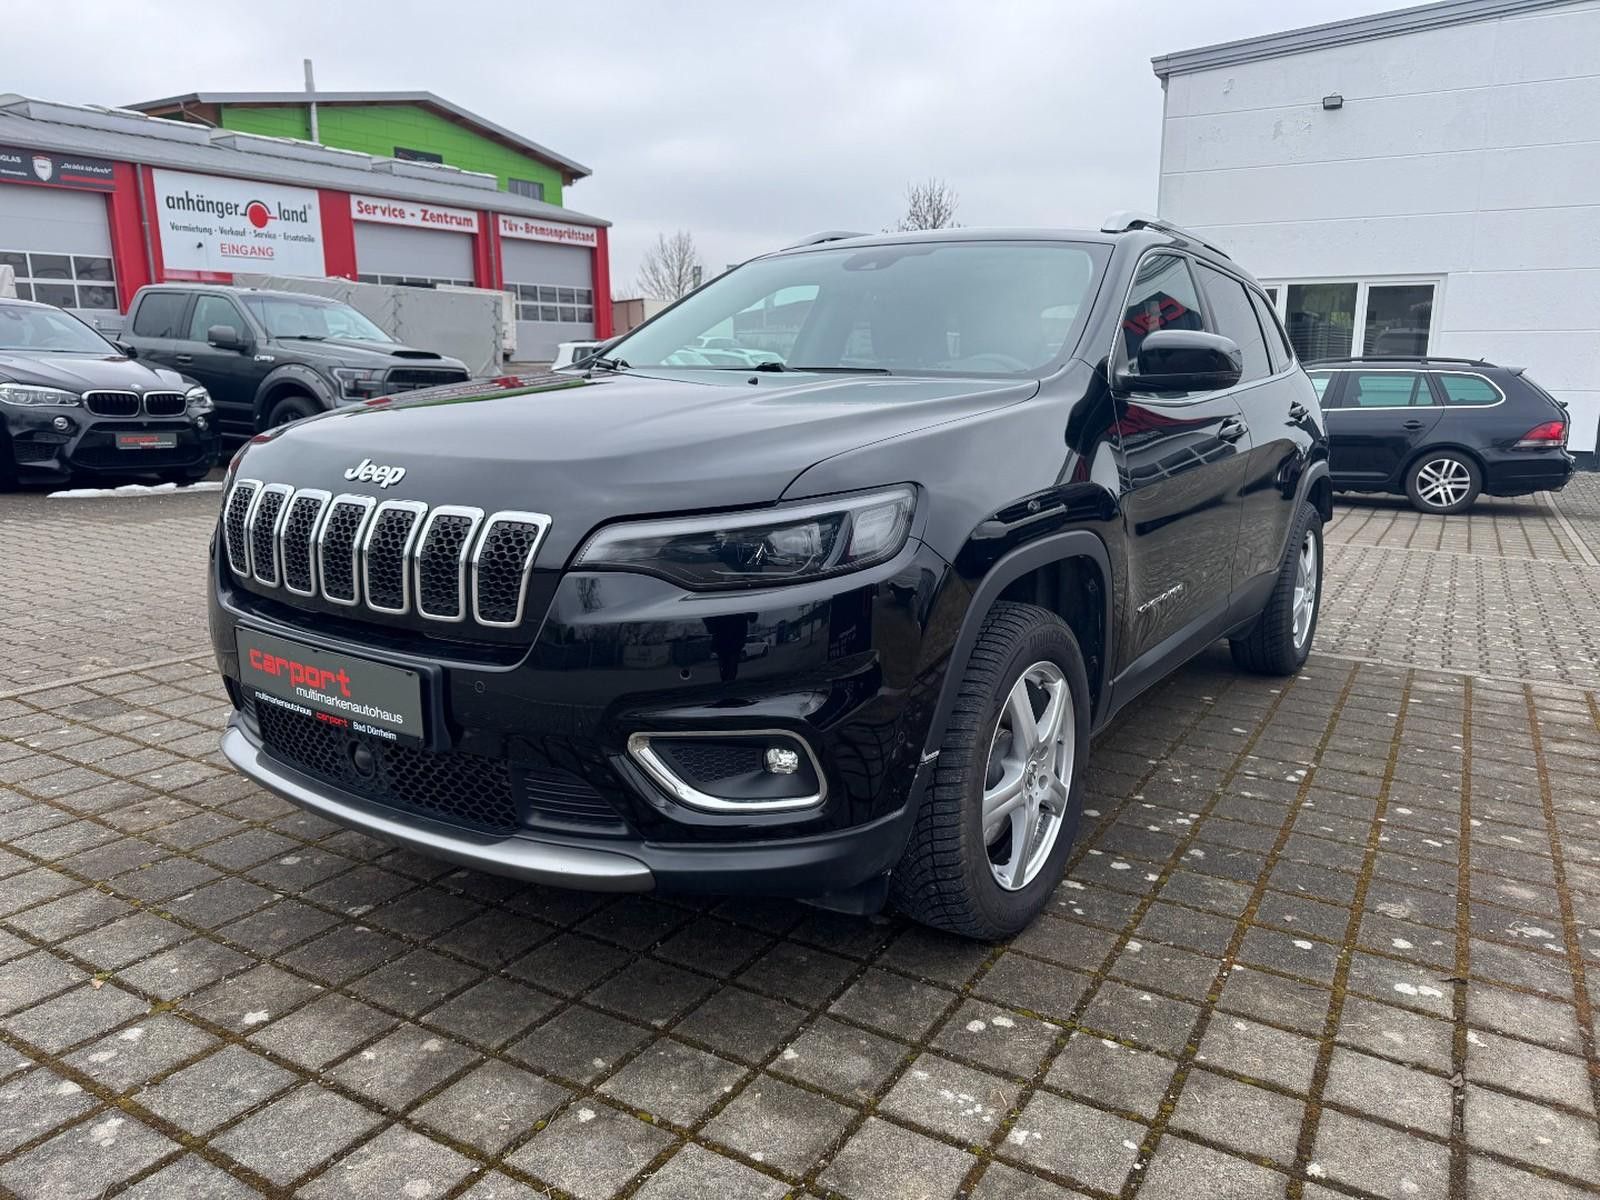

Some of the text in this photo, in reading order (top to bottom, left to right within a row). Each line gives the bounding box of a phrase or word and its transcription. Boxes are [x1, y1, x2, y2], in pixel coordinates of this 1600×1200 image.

[0, 154, 21, 163] GLAS
[165, 190, 308, 223] anhänger land
[357, 200, 406, 219] Service
[420, 208, 474, 228] Zentrum
[169, 220, 213, 236] Vermietung
[218, 225, 246, 237] Verkauf
[252, 229, 277, 239] Service
[220, 243, 275, 257] EINGANG
[344, 458, 407, 489] Jeep
[249, 648, 351, 698] carport
[296, 687, 404, 725] multimarkenautohaus
[315, 711, 349, 728] carport
[352, 720, 366, 733] Bad
